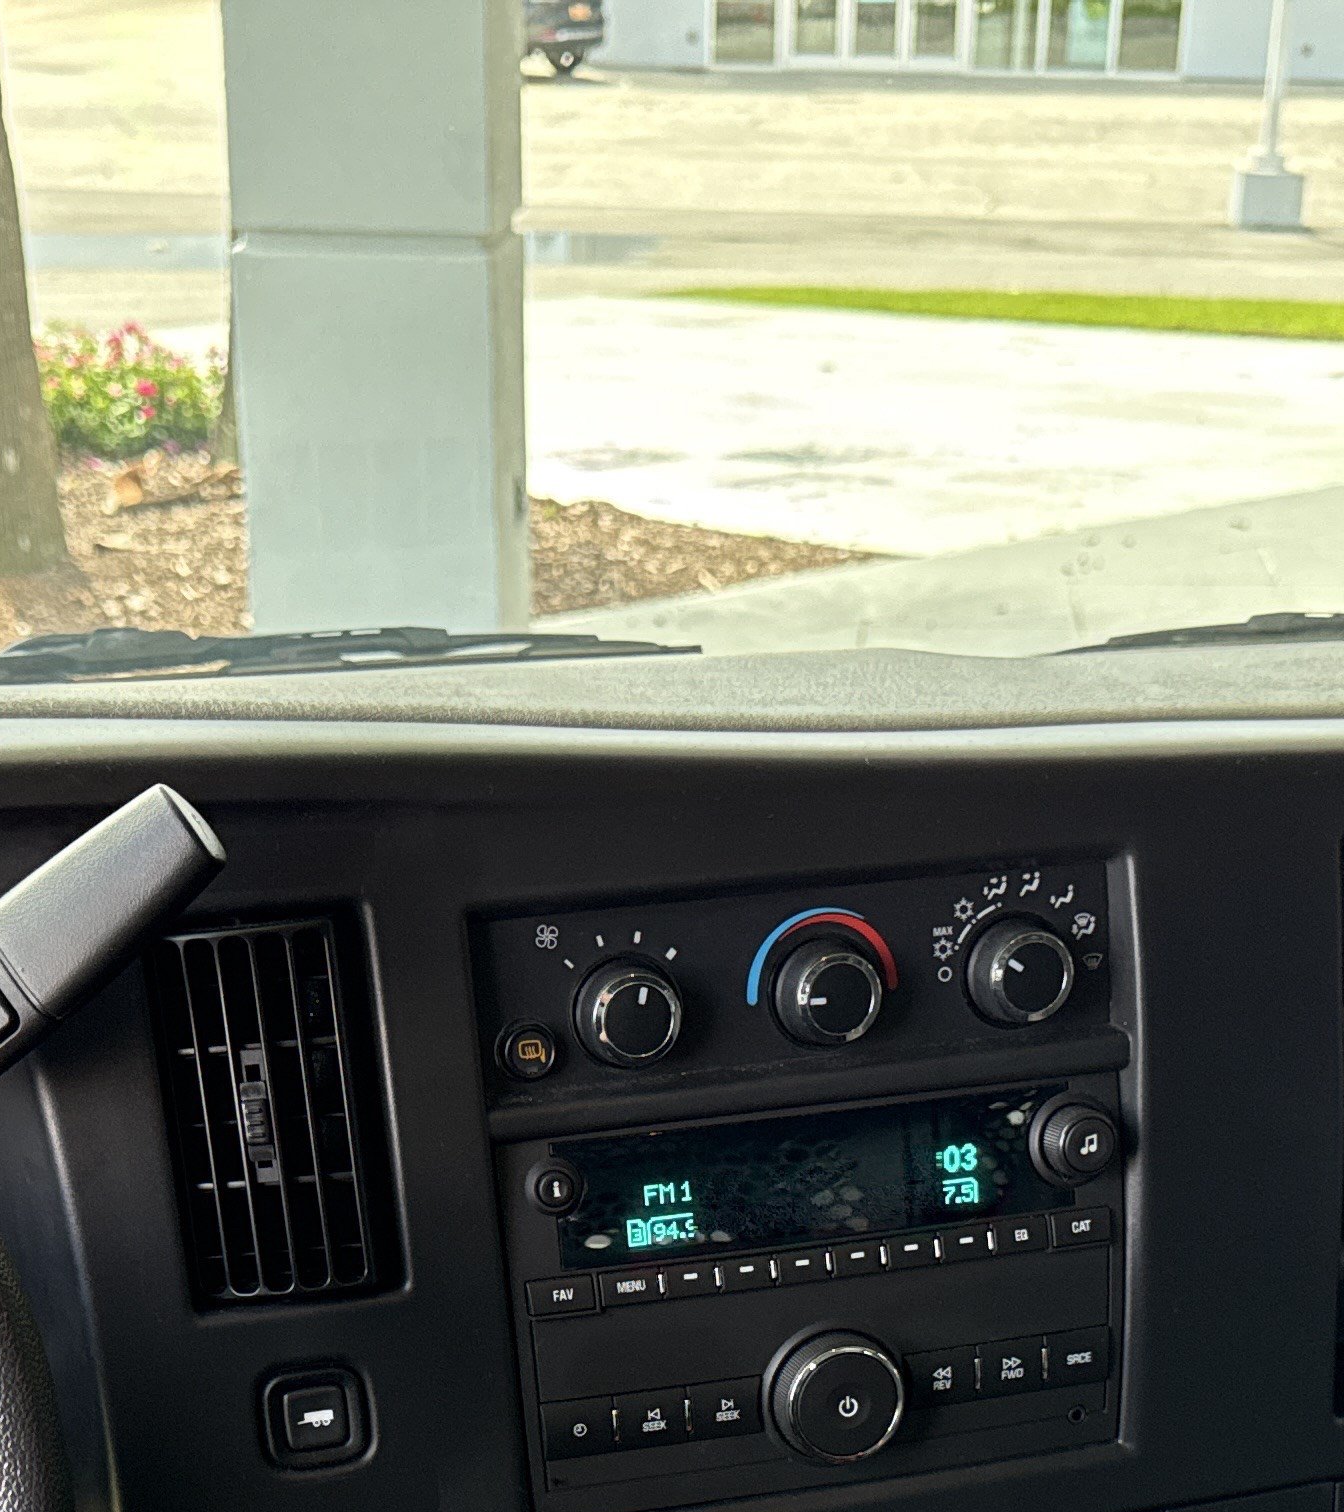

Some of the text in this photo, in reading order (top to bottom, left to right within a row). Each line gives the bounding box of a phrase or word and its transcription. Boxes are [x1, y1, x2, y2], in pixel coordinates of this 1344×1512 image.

[644, 1183, 675, 1206] FM
[1071, 1220, 1091, 1234] CAT
[616, 1279, 647, 1294] MENU
[552, 1288, 574, 1302] FAV
[1066, 1351, 1092, 1365] SRCE
[933, 1379, 952, 1391] REV
[716, 1409, 740, 1421] SEEK
[642, 1420, 666, 1432] SEEK
